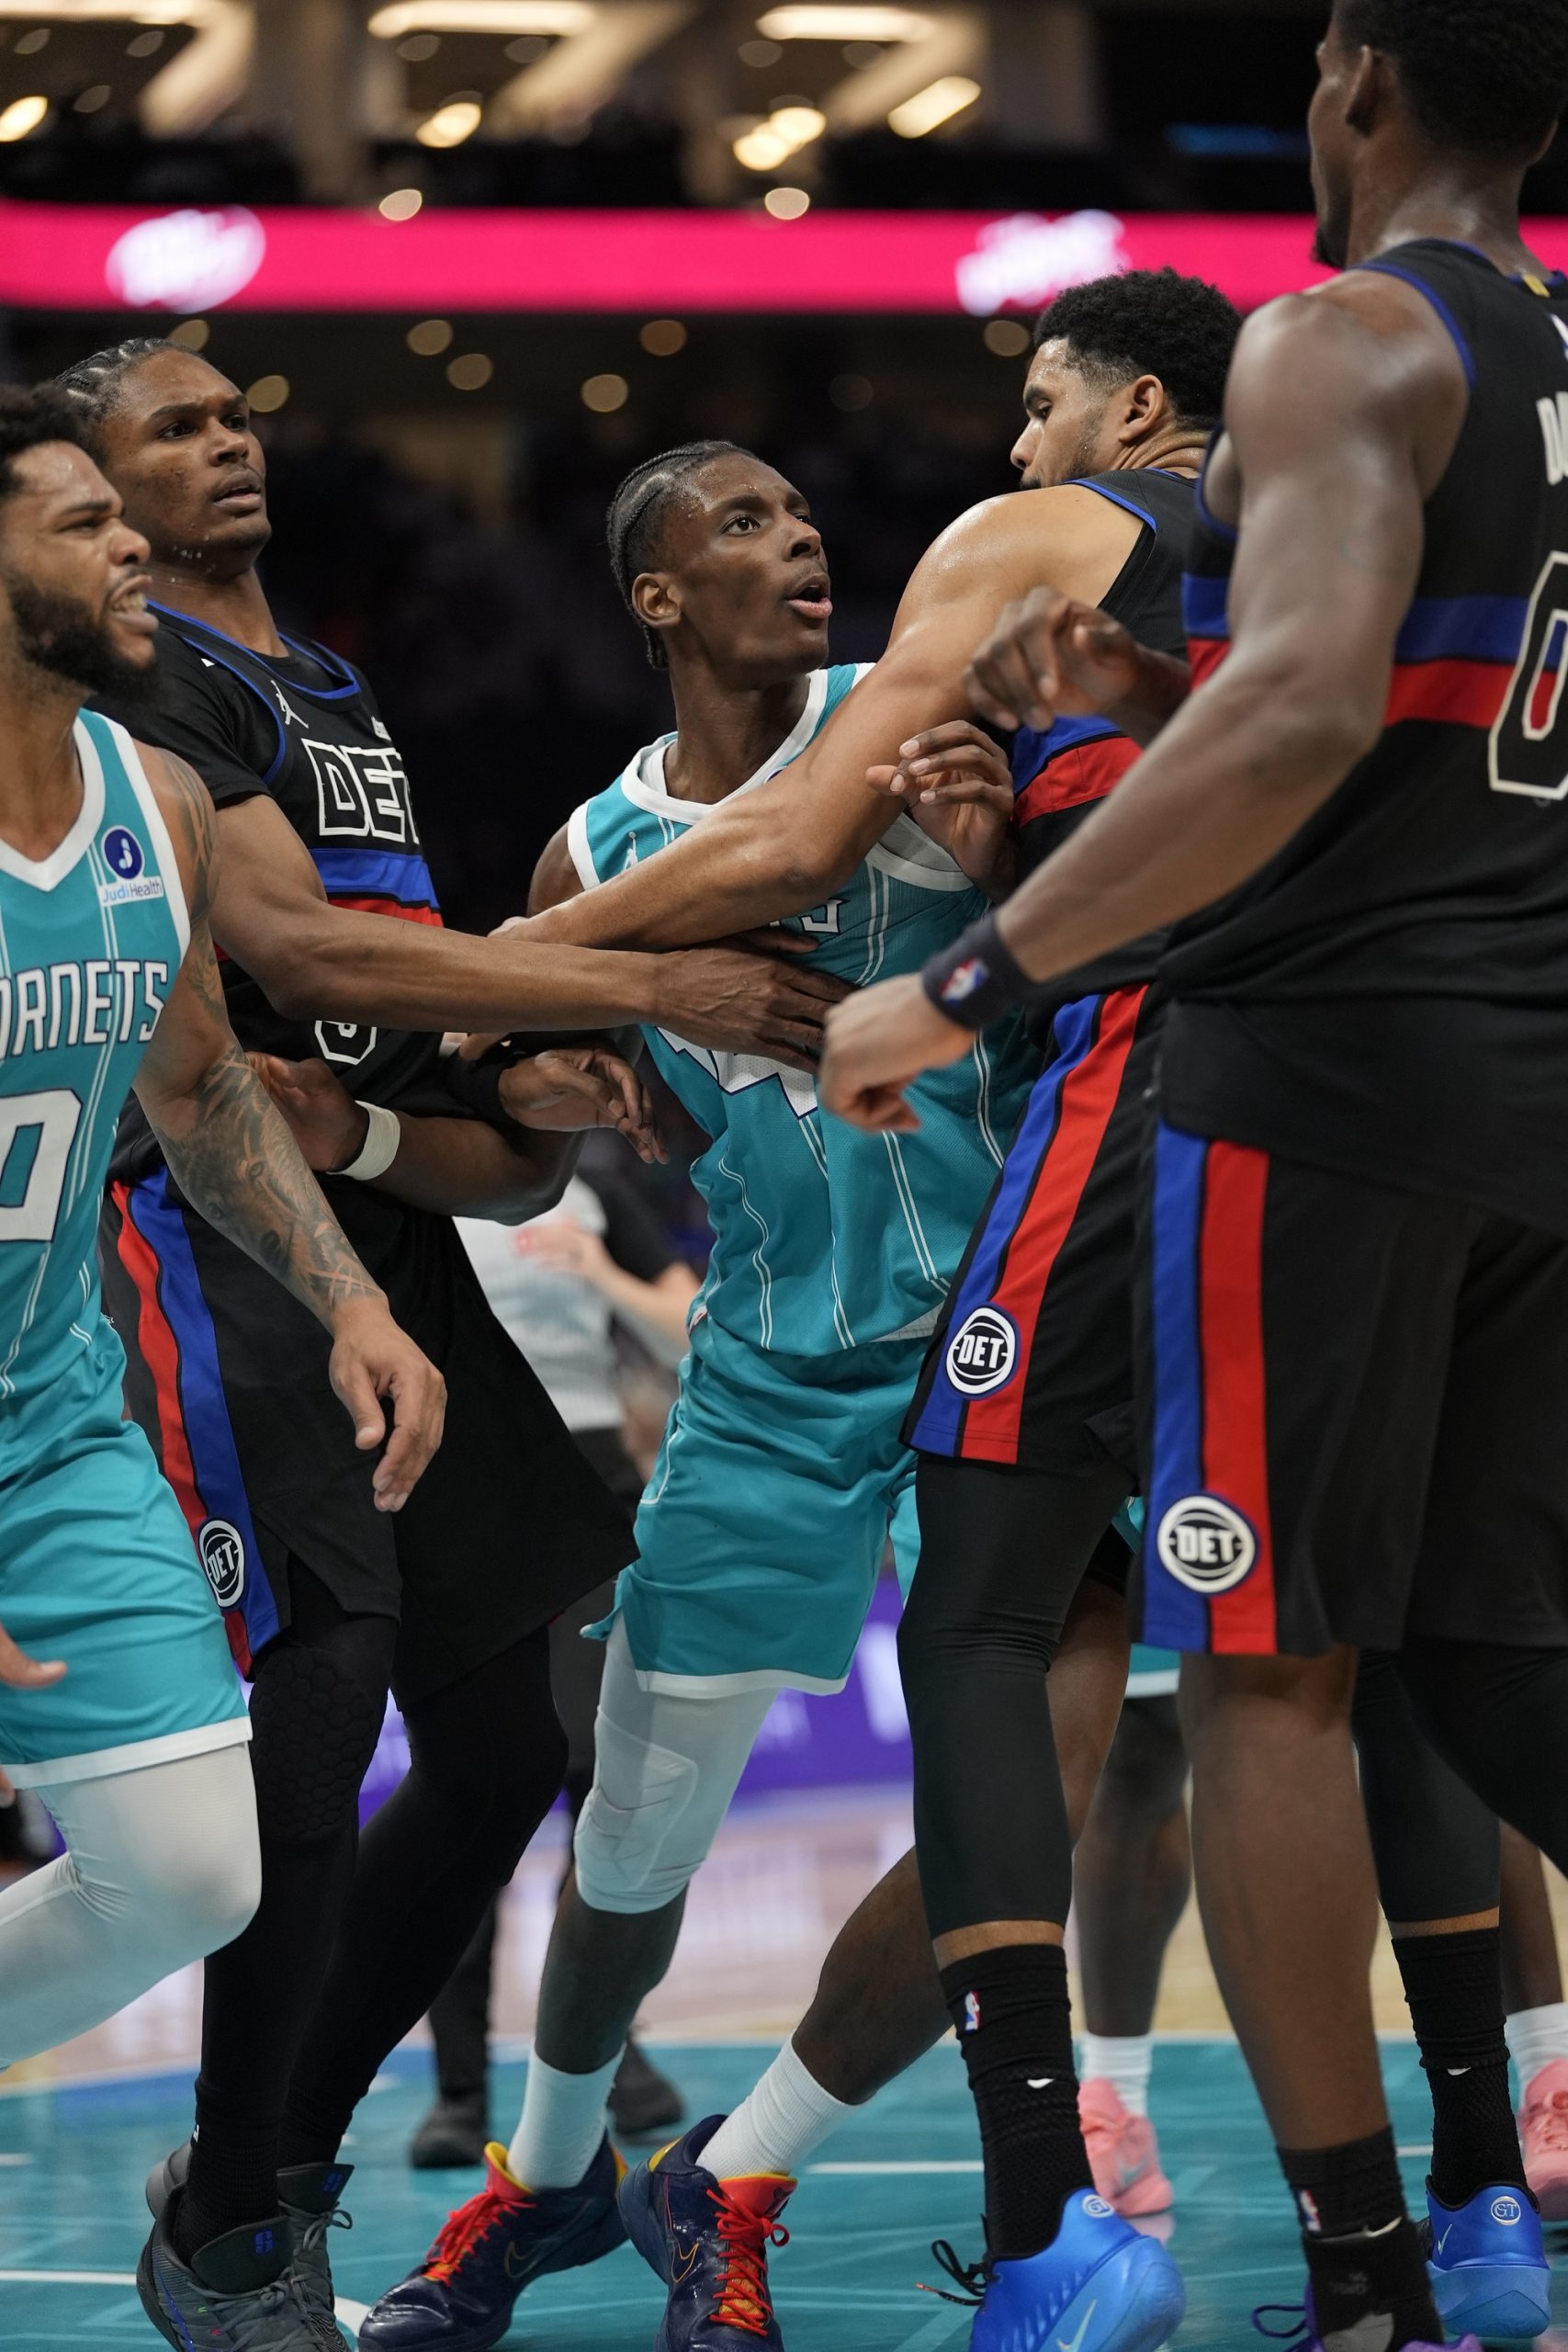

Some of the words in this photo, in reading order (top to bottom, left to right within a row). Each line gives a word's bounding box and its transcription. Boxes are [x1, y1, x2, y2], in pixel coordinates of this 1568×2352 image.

[957, 1334, 1005, 1369] DET
[1176, 1525, 1235, 1563] DET
[208, 1540, 235, 1585] DET
[1495, 2203, 1517, 2217] GT
